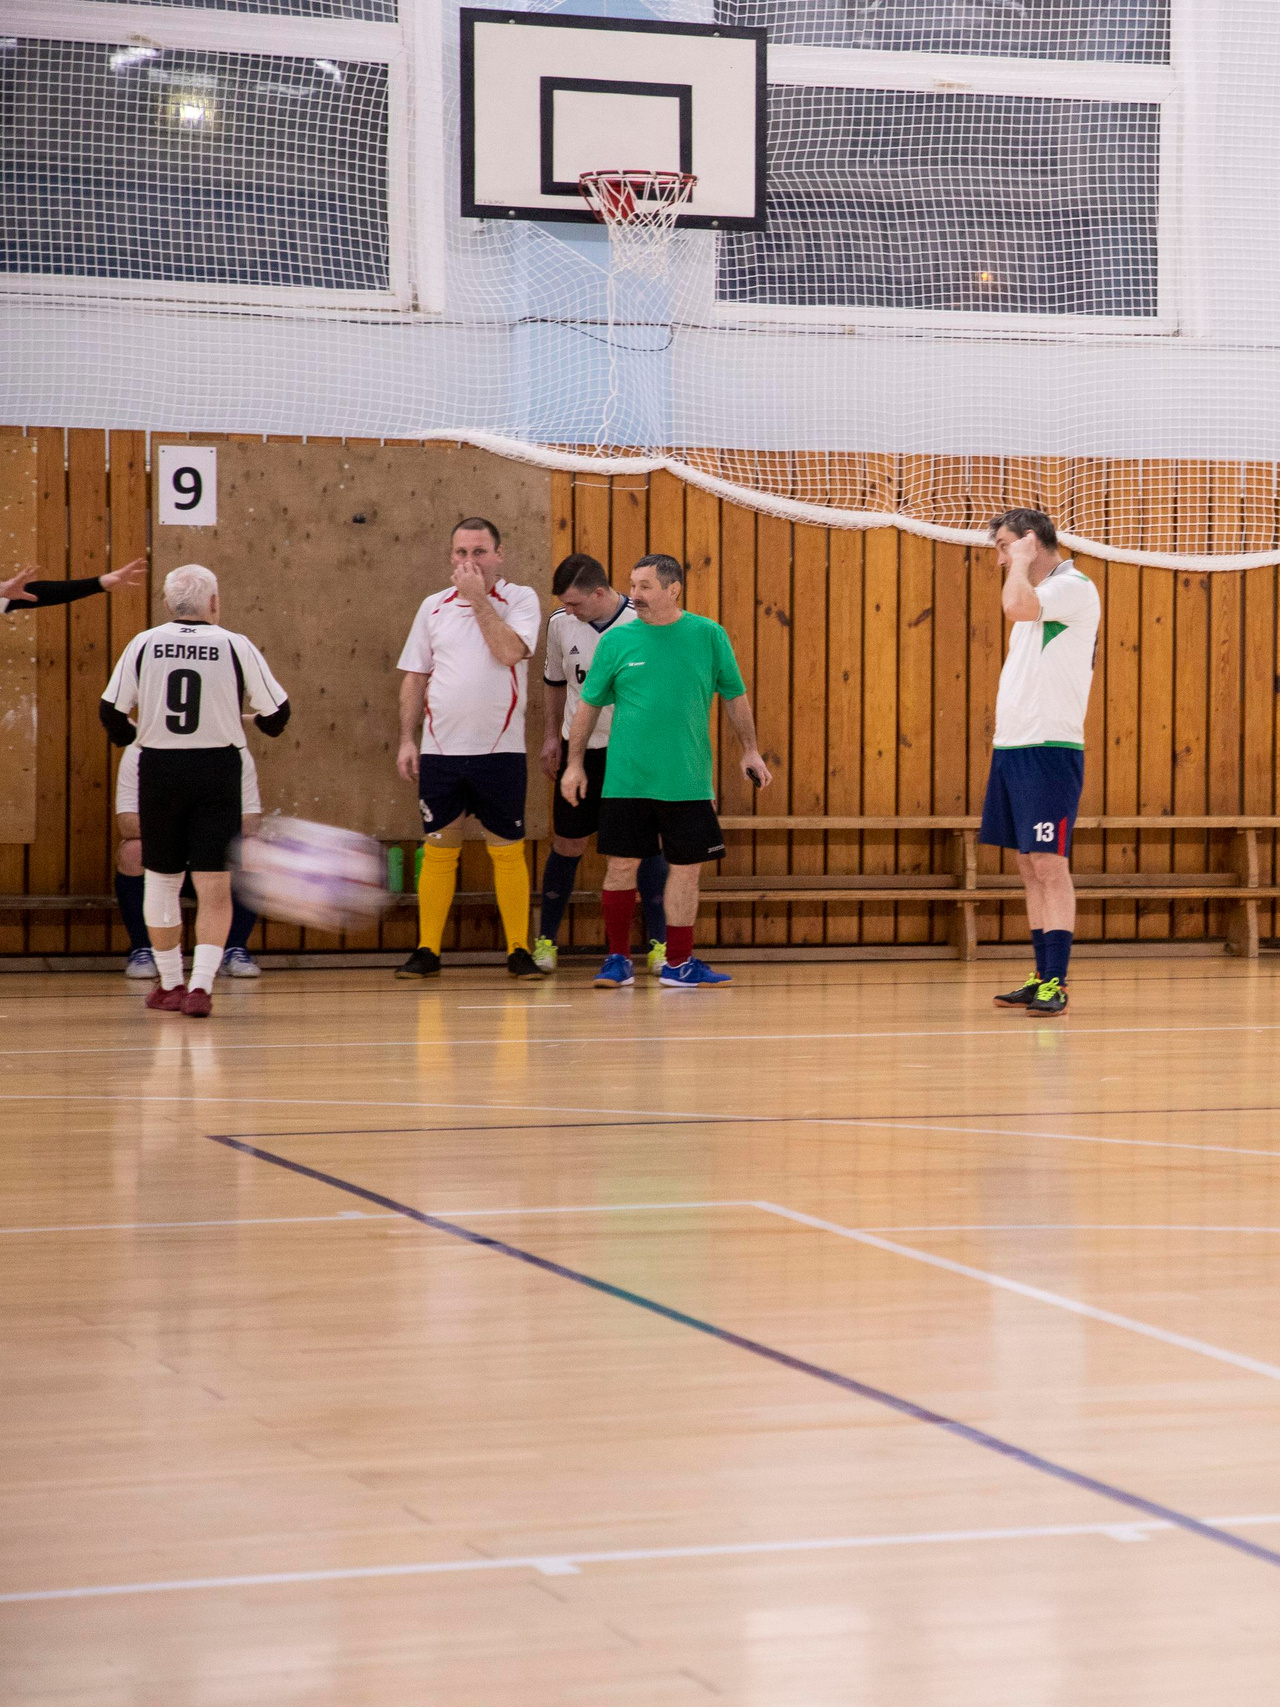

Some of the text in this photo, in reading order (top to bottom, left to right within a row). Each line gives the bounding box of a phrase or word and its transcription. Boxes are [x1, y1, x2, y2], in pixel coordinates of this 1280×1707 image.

[173, 467, 202, 510] 9
[154, 644, 219, 661] БЕЛЯЕВ
[166, 669, 202, 735] 9
[1033, 821, 1055, 843] 13
